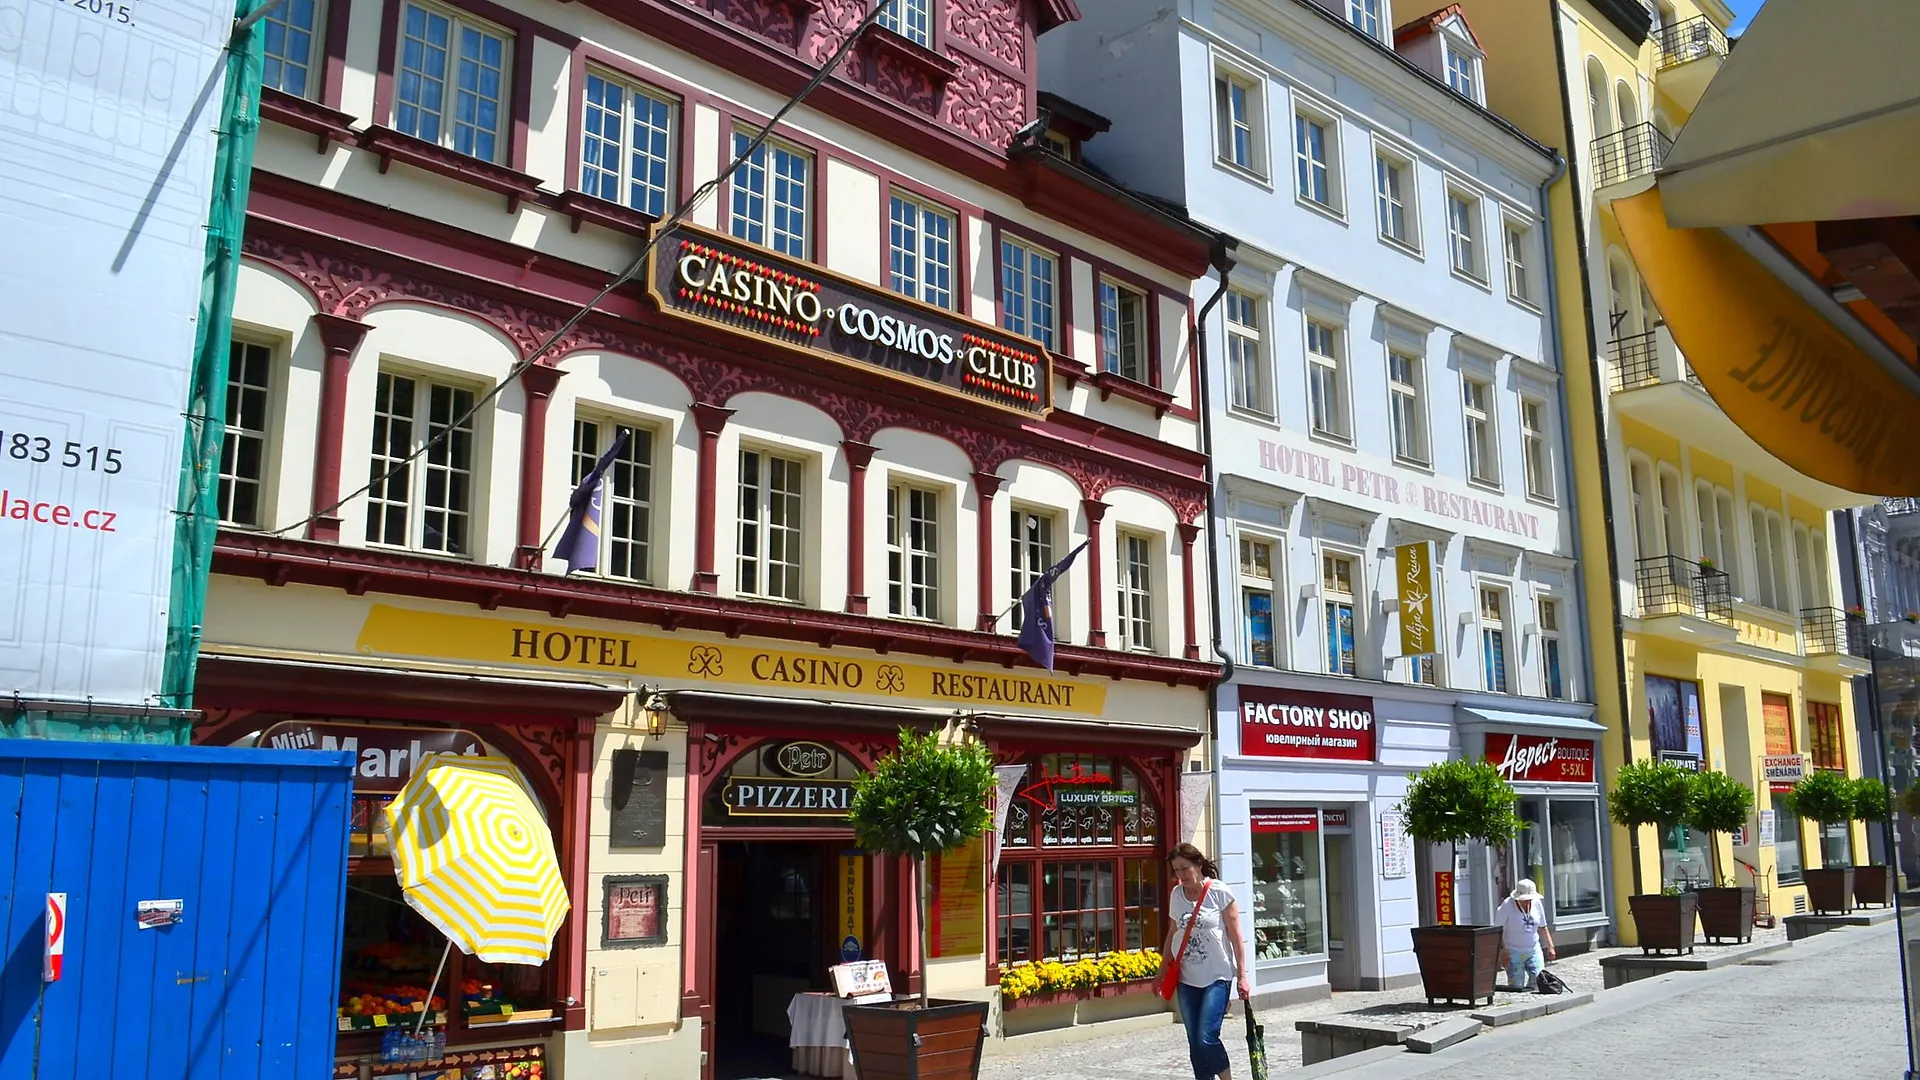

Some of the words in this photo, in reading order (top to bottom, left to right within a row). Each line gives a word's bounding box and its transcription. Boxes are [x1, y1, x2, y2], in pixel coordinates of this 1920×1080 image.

[680, 255, 821, 322] CASINO
[839, 303, 953, 364] COSMOS
[968, 346, 1037, 389] CLUB
[62, 441, 123, 474] 515
[1258, 438, 1335, 488] HOTEL
[1341, 462, 1401, 505] PETR
[1423, 485, 1539, 540] RESTAURANT
[0, 489, 117, 532] lace.cz
[1406, 546, 1422, 584] Reisen
[511, 628, 637, 668] HOTEL
[751, 653, 864, 688] CASINO
[931, 671, 1074, 707] RESTAURANT
[1244, 702, 1324, 728] FACTORY
[1328, 708, 1372, 731] SHOP
[271, 727, 315, 750] Mini
[1266, 734, 1320, 748] ювелирный
[1322, 737, 1358, 748] магазин
[320, 735, 480, 778] ark
[787, 745, 827, 770] Petr
[1496, 734, 1558, 781] Aspect
[1557, 748, 1590, 762] BOUTIQUE
[1561, 763, 1585, 776] S-5XL
[1765, 758, 1801, 767] EXCHANGE
[1765, 766, 1802, 778] SMĚNÁRNA
[737, 785, 862, 809] PIZZERI
[1060, 794, 1100, 803] LUXURY
[1101, 794, 1135, 804] OPTICS
[615, 886, 652, 905] Petr
[847, 857, 855, 935] BANKOMAT
[1440, 873, 1450, 921] CHANGE
